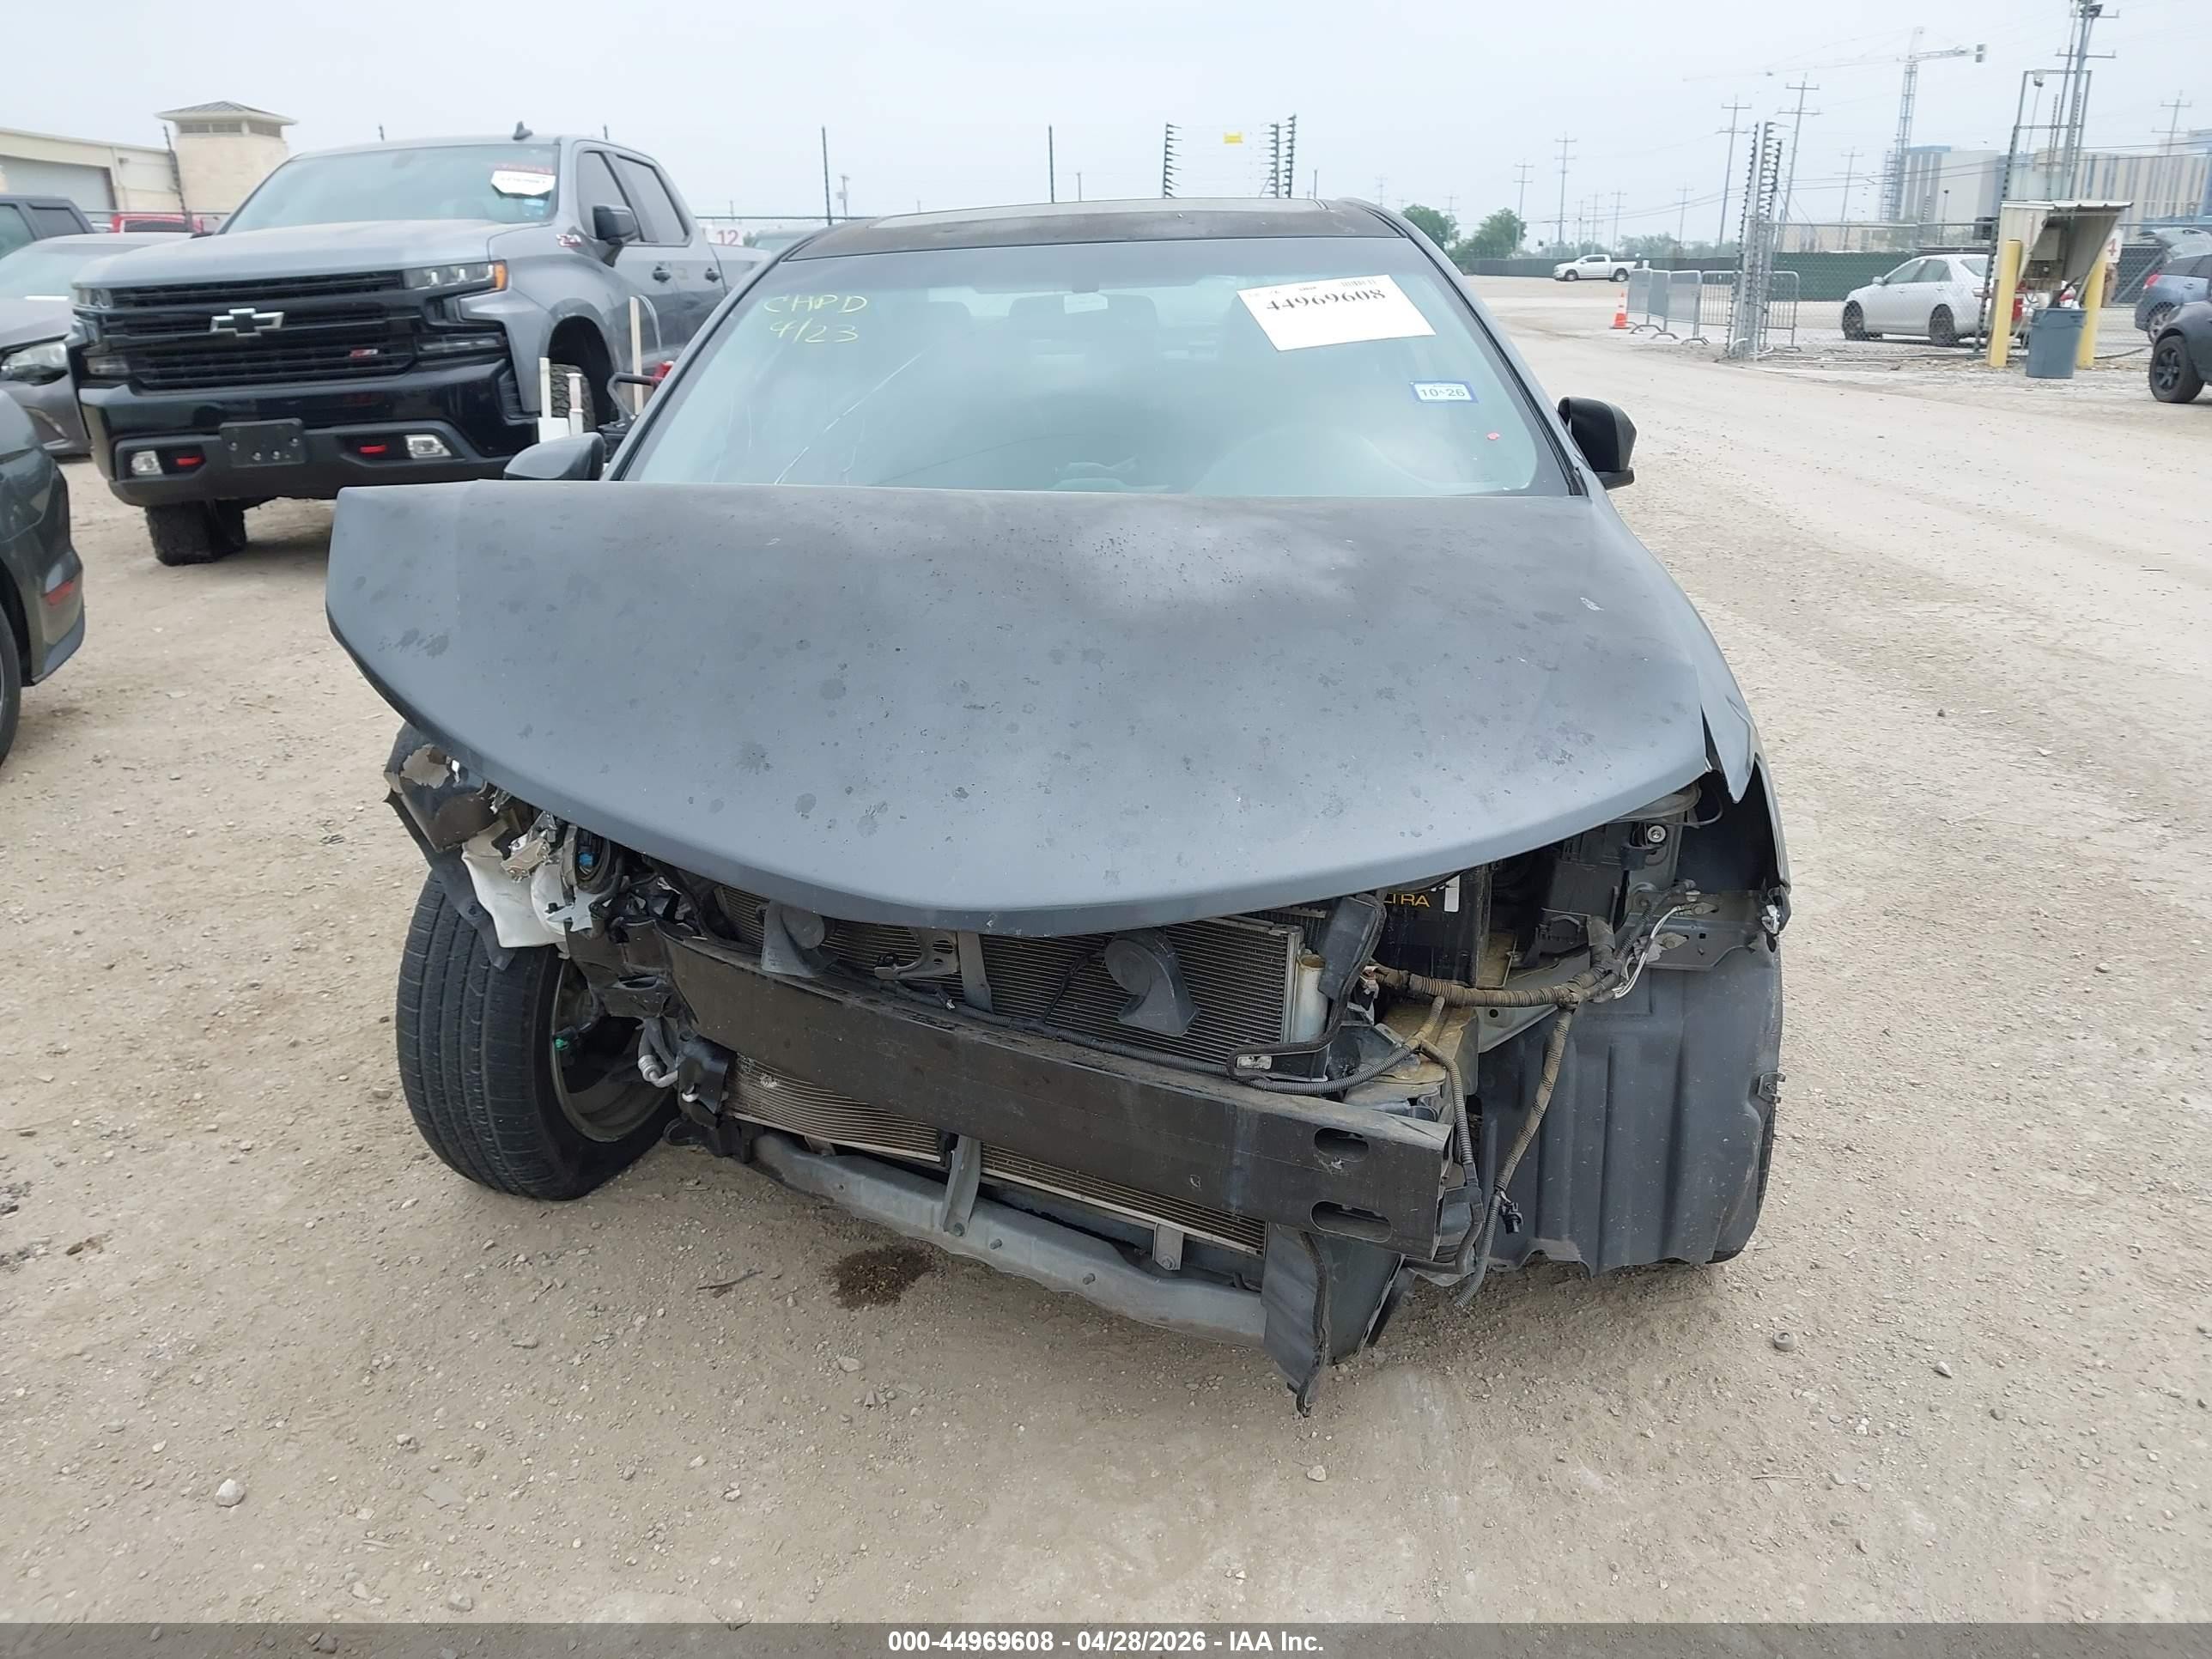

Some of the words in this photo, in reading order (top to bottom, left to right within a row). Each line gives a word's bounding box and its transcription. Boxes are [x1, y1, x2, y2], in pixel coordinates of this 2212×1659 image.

[716, 229, 739, 246] 12
[763, 294, 868, 313] CHPD
[1266, 289, 1387, 311] 44969608
[769, 309, 859, 343] 4/23
